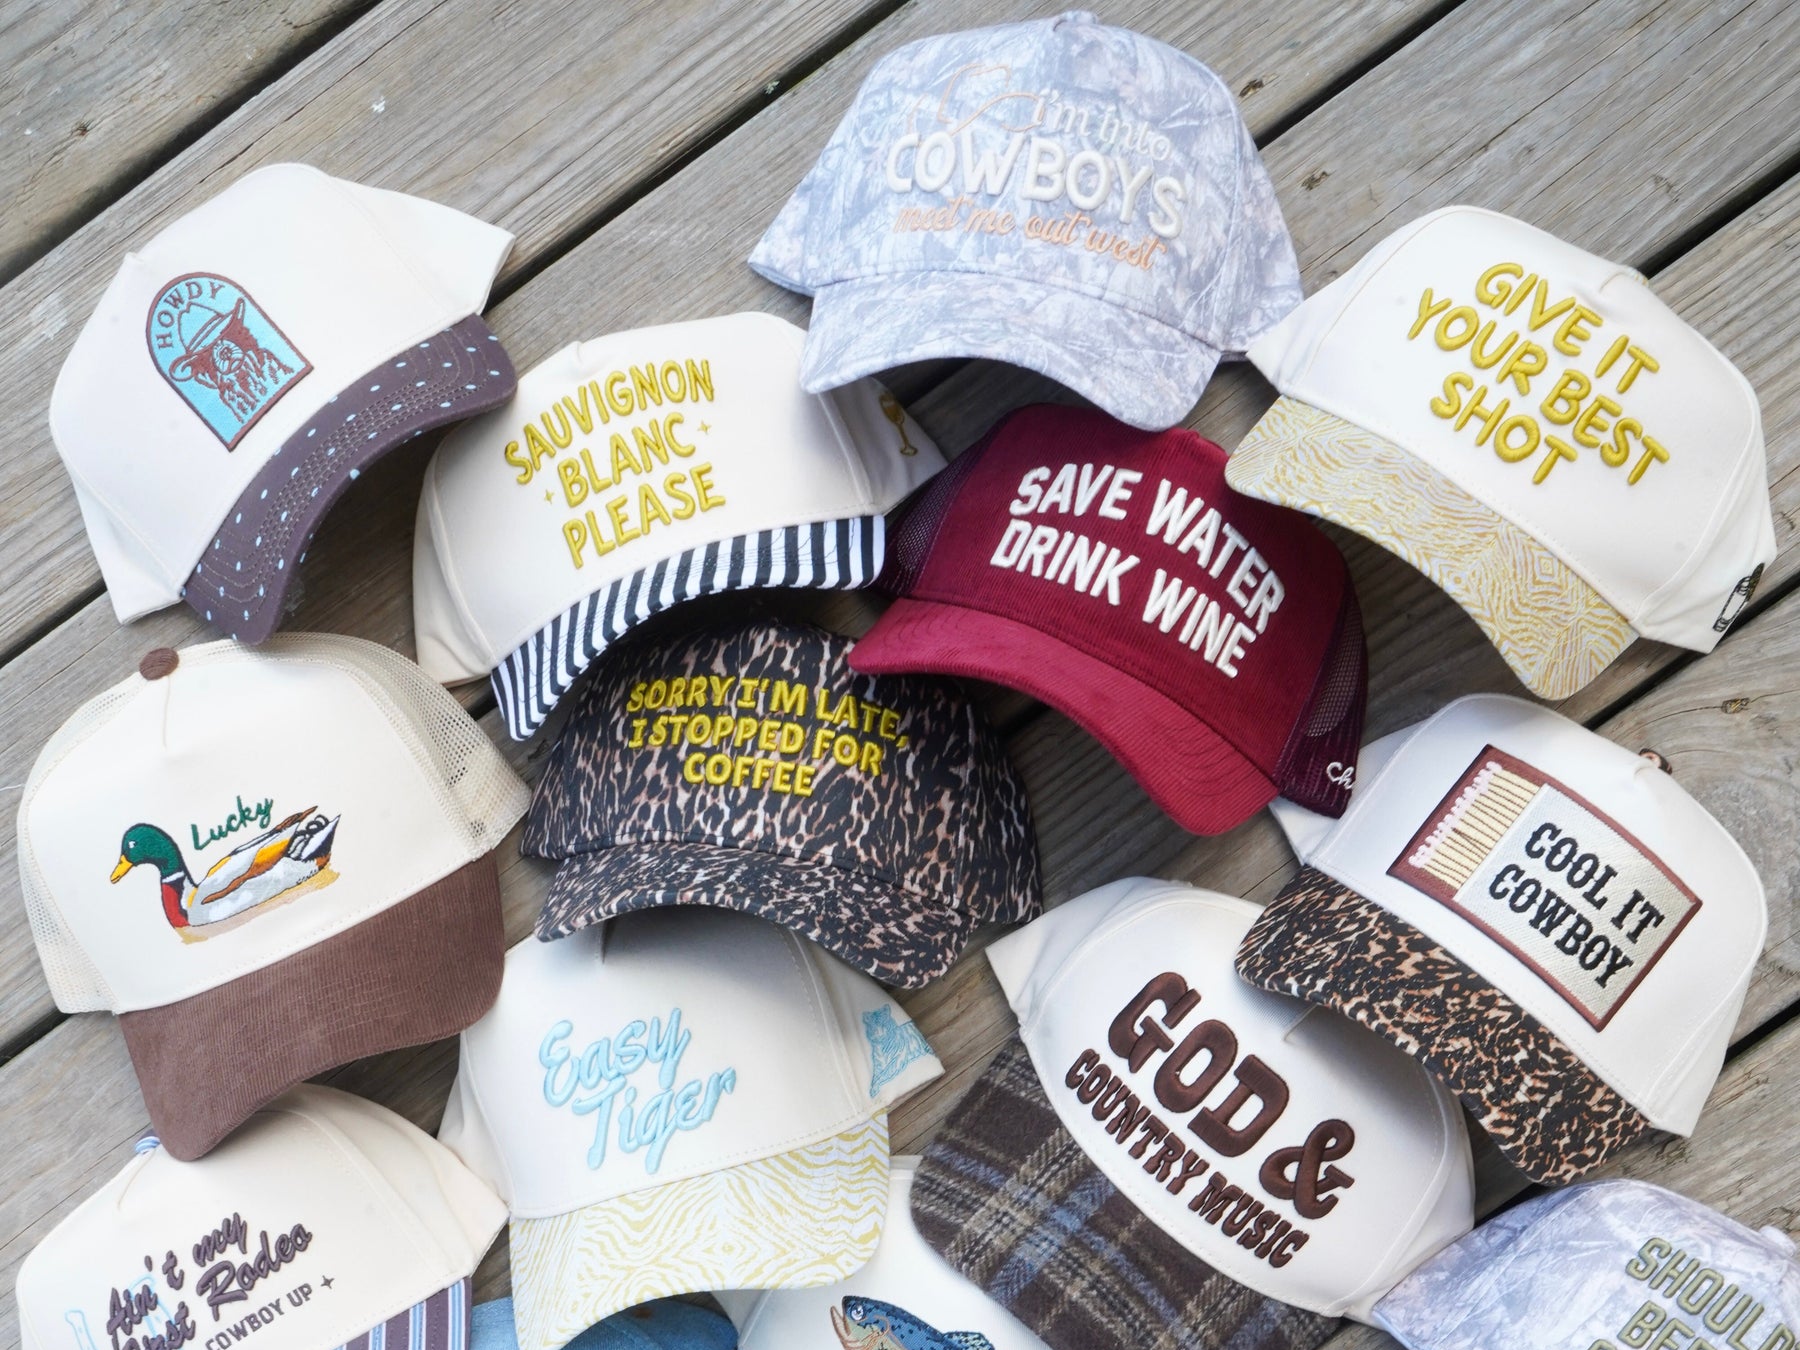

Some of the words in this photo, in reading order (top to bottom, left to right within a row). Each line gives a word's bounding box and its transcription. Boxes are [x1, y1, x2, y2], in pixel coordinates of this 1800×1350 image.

[886, 129, 1186, 239] COWBOYS
[1100, 106, 1172, 160] into
[893, 196, 974, 233] meet
[963, 207, 1015, 235] me
[1025, 211, 1093, 245] out
[1085, 230, 1167, 270] west
[156, 281, 225, 350] HOWDY
[1475, 263, 1603, 356] GIVE
[1595, 335, 1659, 393] IT
[505, 359, 714, 484] SAUVIGNON
[1408, 288, 1547, 396] YOUR
[1540, 368, 1670, 485] BEST
[1430, 371, 1578, 485] SHOT
[558, 412, 696, 508] BLANC
[563, 462, 726, 569] PLEASE
[1009, 463, 1143, 520] SAVE
[1146, 479, 1285, 634] WATER
[990, 519, 1140, 605] DRINK
[1142, 569, 1256, 678] WINE
[627, 675, 736, 712] SORRY
[737, 678, 808, 716] I'M
[815, 688, 909, 747] LATE,
[628, 719, 647, 748] I
[649, 714, 804, 754] STOPPED
[812, 729, 884, 776] FOR
[191, 795, 273, 850] Lucky
[684, 753, 816, 797] COFFEE
[1489, 864, 1633, 989] COWBOY
[1525, 822, 1617, 910] COOL
[1610, 889, 1665, 944] IT
[539, 1008, 691, 1107] Easy
[1108, 972, 1290, 1157] GOD
[1259, 1118, 1355, 1219] &
[573, 1067, 736, 1175] Tiger
[1065, 1049, 1209, 1195] COUNTRY
[1188, 1172, 1309, 1268] MUSIC
[192, 1212, 247, 1267] my
[196, 1224, 312, 1322] Rodeo
[286, 1283, 312, 1308] UP
